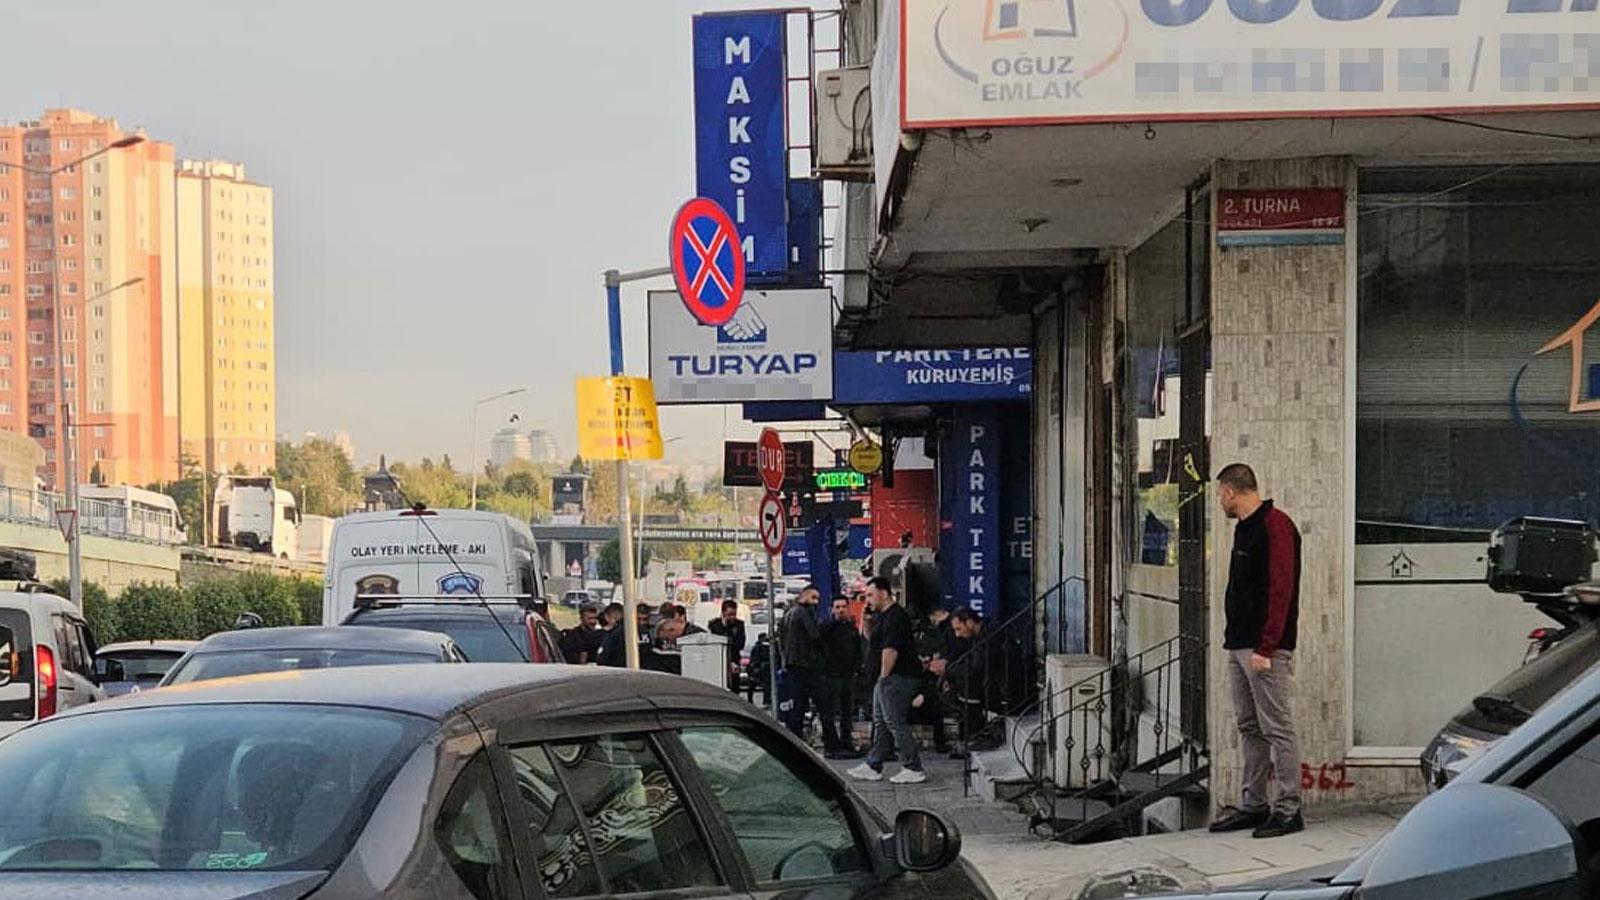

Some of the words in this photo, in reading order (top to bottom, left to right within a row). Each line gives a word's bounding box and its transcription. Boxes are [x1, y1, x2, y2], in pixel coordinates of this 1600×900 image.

[991, 52, 1074, 76] OĞUZ
[981, 80, 1084, 101] EMLAK
[1224, 199, 1238, 214] 2.
[1244, 198, 1300, 214] TURNA
[668, 353, 817, 376] TURYAP
[907, 364, 1014, 385] KURUYEMİŞ
[761, 447, 783, 472] DUR
[969, 426, 984, 514] PARK
[351, 546, 377, 557] OLAY
